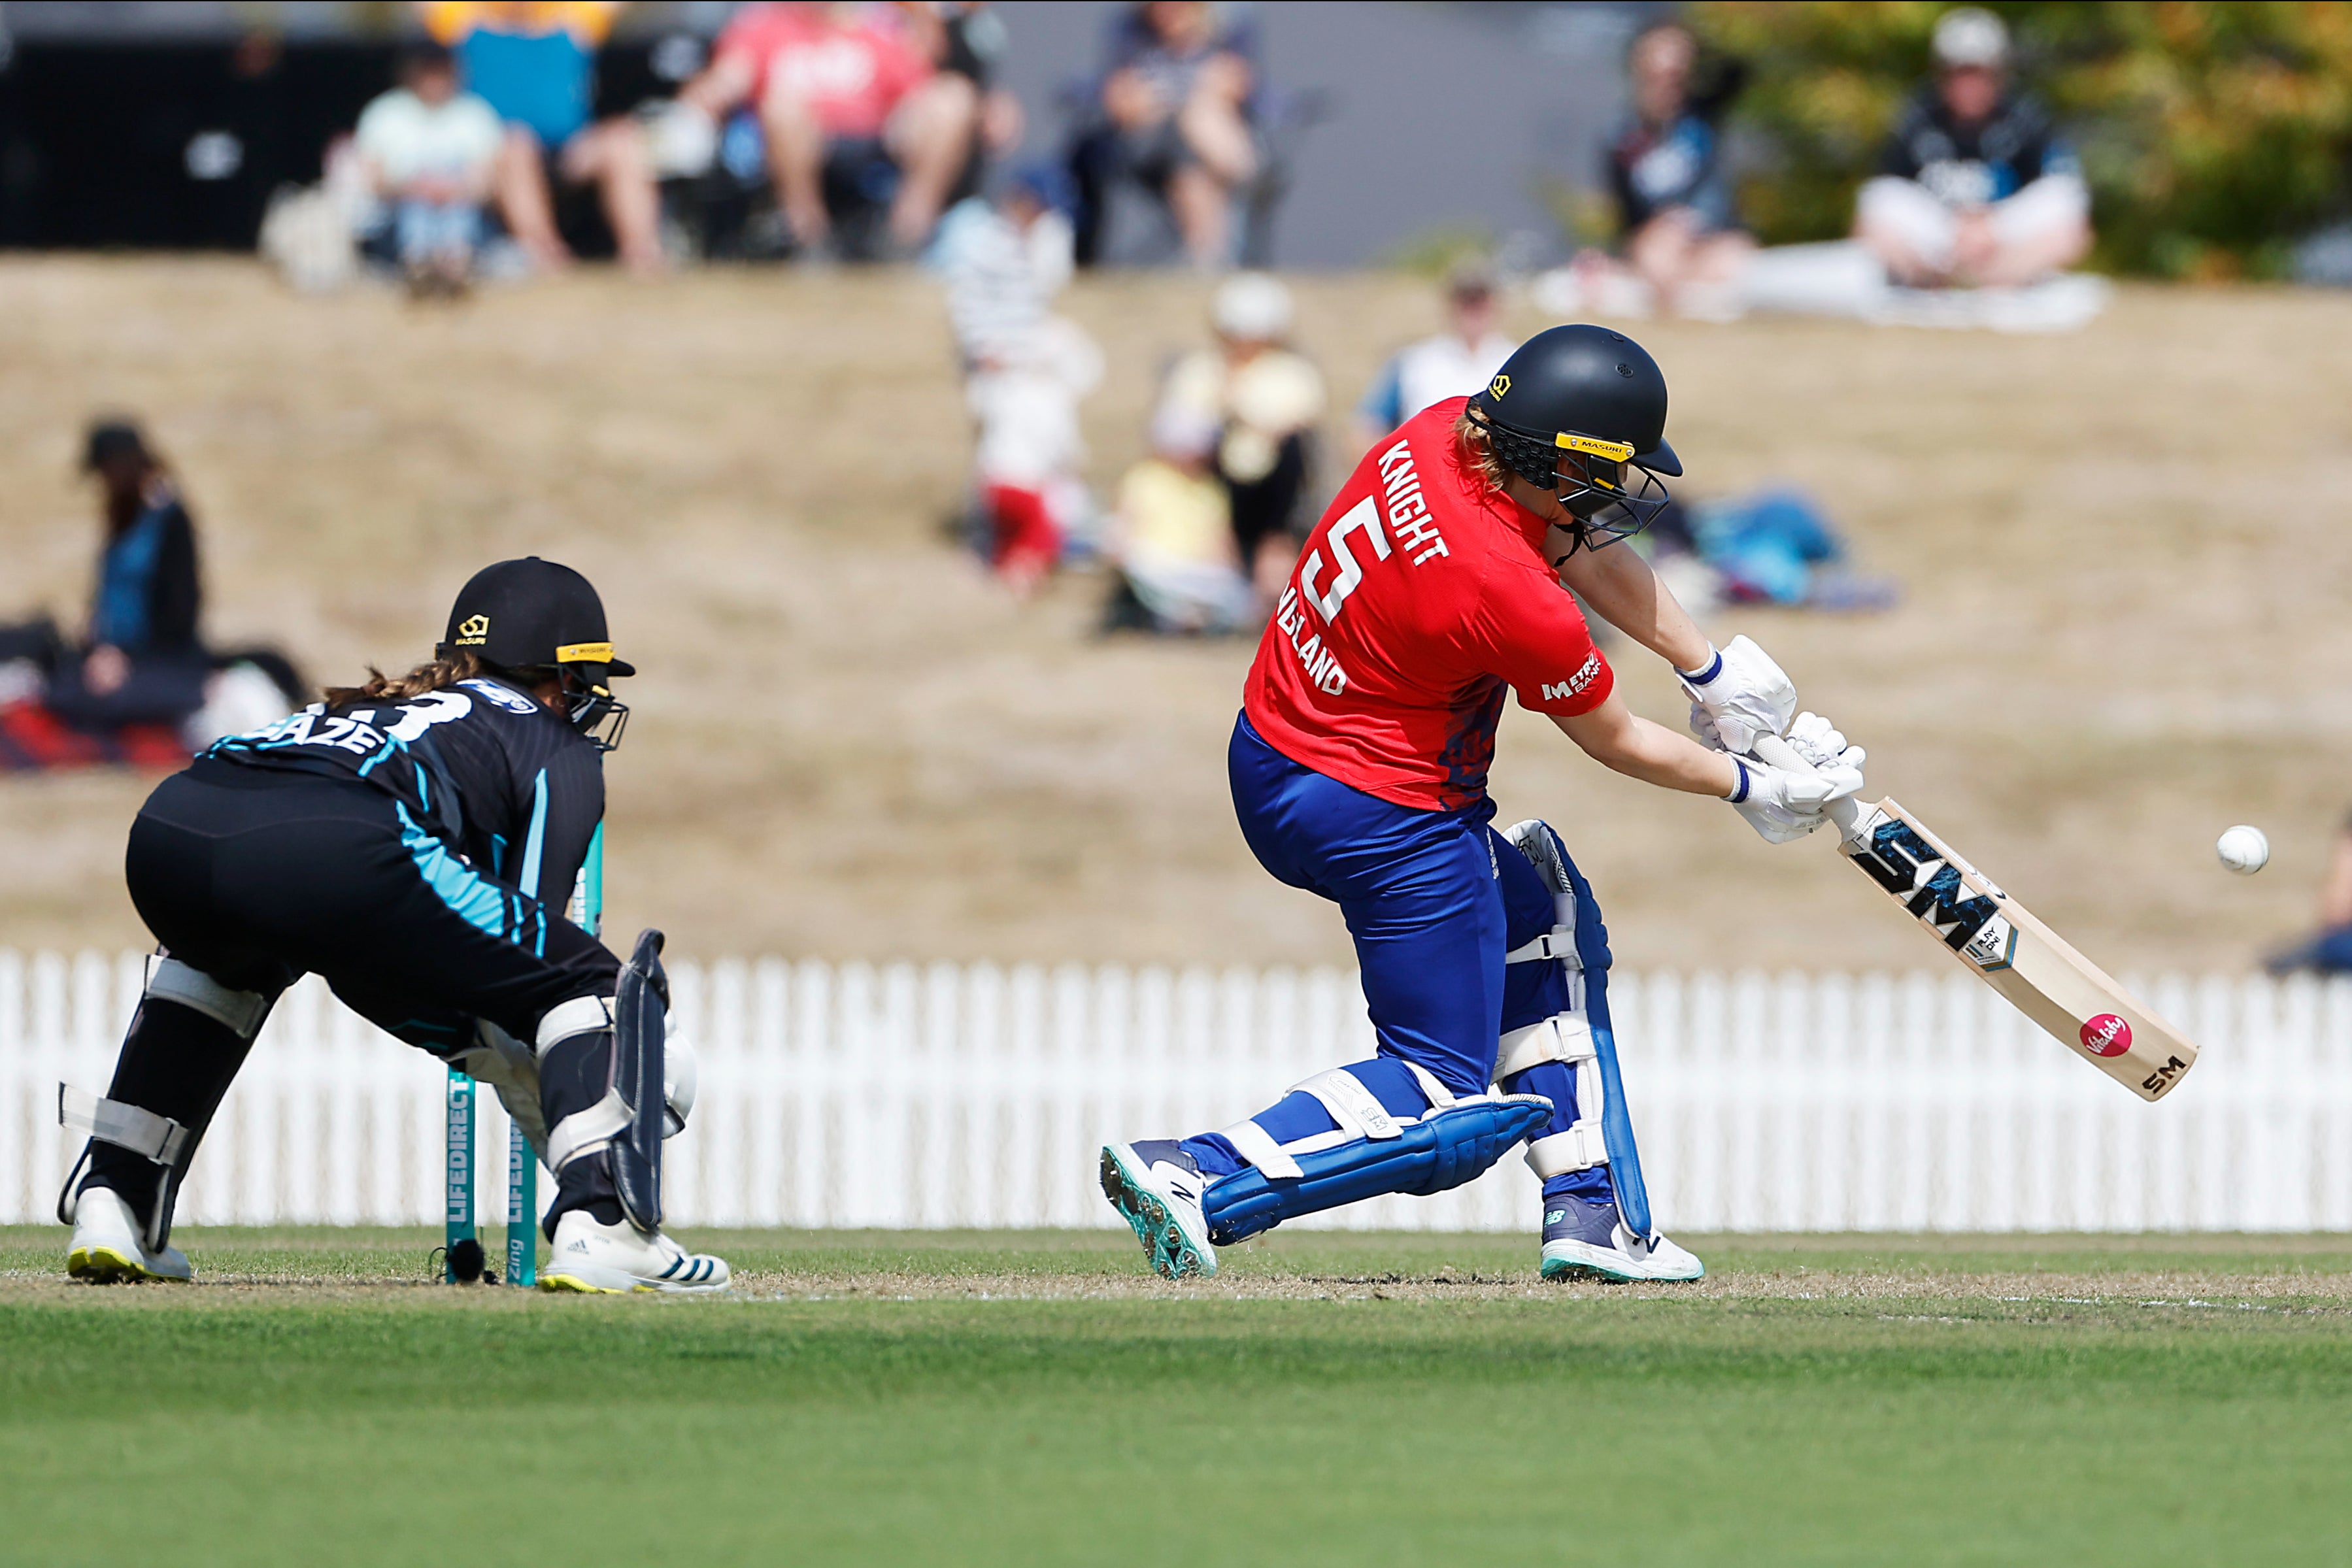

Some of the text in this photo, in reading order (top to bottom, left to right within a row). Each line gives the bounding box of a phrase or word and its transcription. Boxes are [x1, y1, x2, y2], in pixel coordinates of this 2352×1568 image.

[1582, 441, 1622, 453] MASURI
[1378, 439, 1450, 567] KNIGHT
[1300, 494, 1392, 627] 5
[1277, 579, 1348, 696] NGLAND
[1541, 652, 1595, 701] METRO
[1574, 658, 1602, 693] BANK
[1849, 816, 2000, 953] SM
[1976, 926, 1996, 948] PLAY
[2086, 1016, 2126, 1054] Vitality
[2142, 1055, 2187, 1095] SM
[1360, 1107, 1389, 1131] SM
[448, 1078, 470, 1223] LIFEDIRECT
[508, 1115, 524, 1224] LIFEDIR
[509, 1239, 524, 1280] Zing
